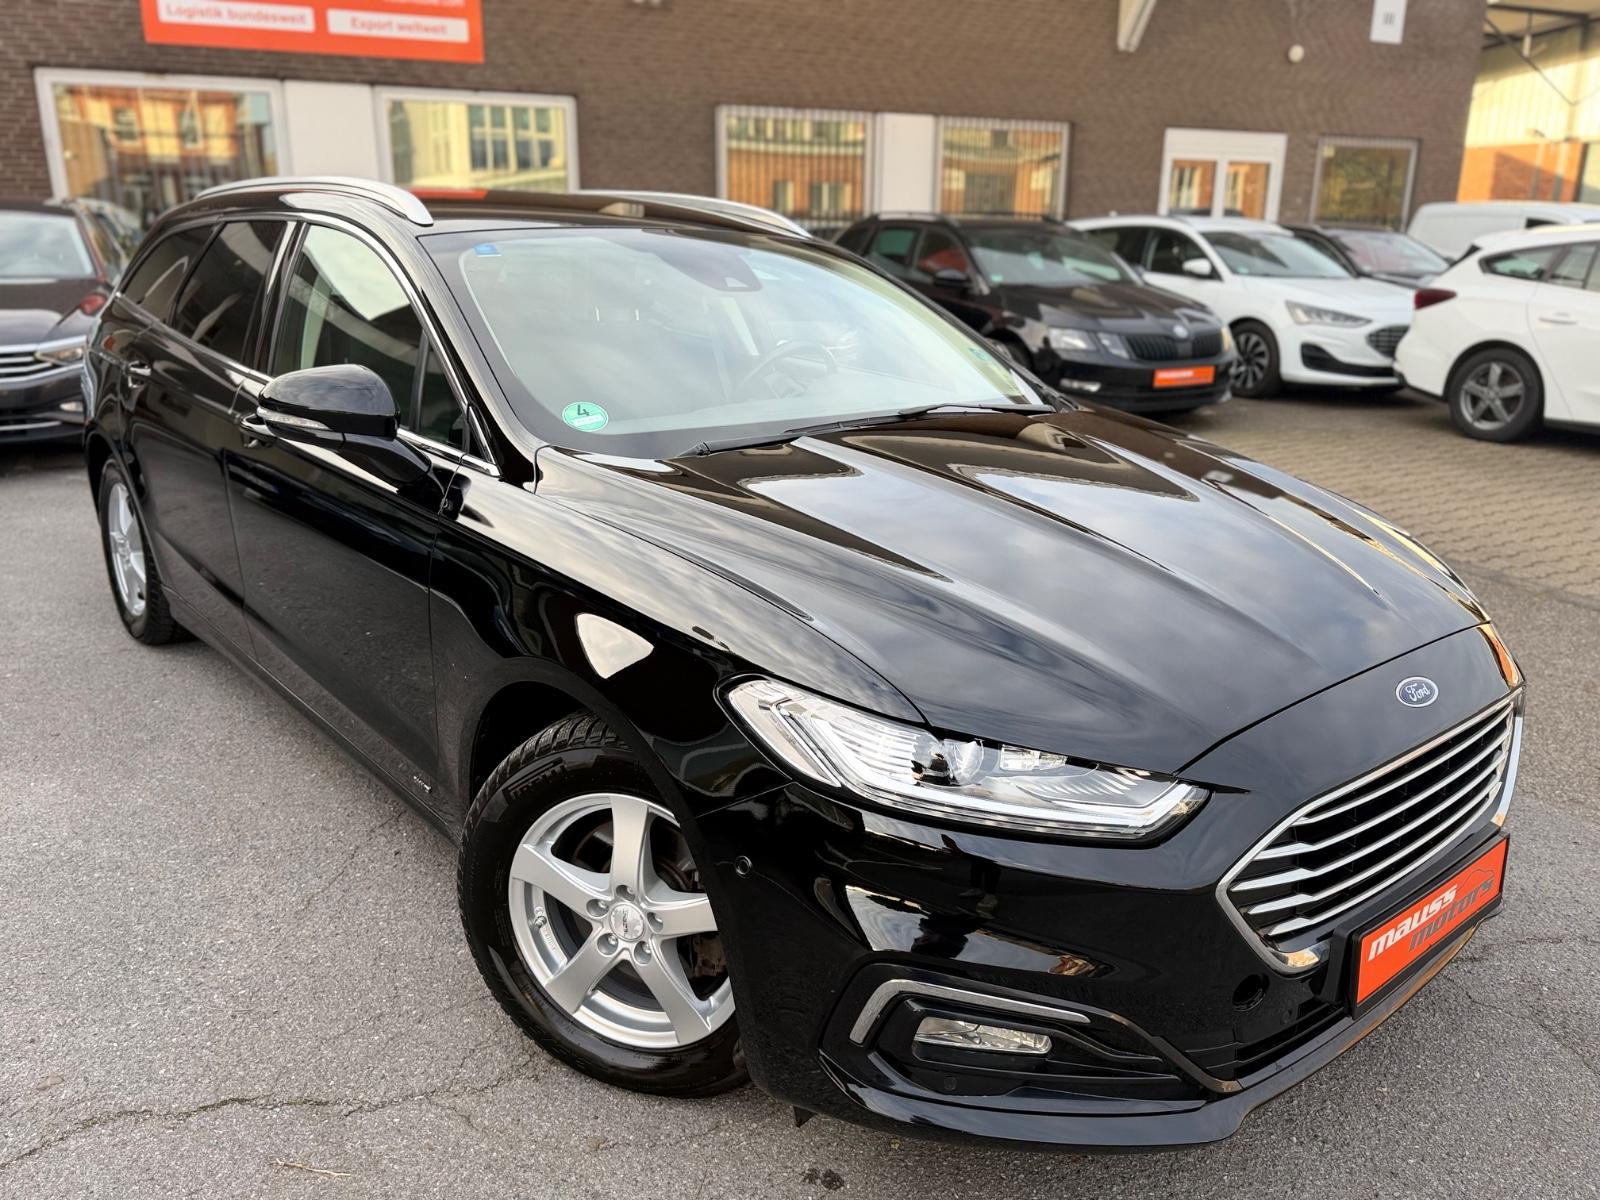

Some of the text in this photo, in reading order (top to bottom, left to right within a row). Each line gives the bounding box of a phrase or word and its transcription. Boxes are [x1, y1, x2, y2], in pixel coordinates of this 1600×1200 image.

[165, 4, 306, 24] Logistik bundesweit
[350, 17, 447, 34] Export weltweit
[577, 404, 589, 416] 4
[1405, 682, 1431, 702] Ford
[1409, 878, 1494, 952] motors
